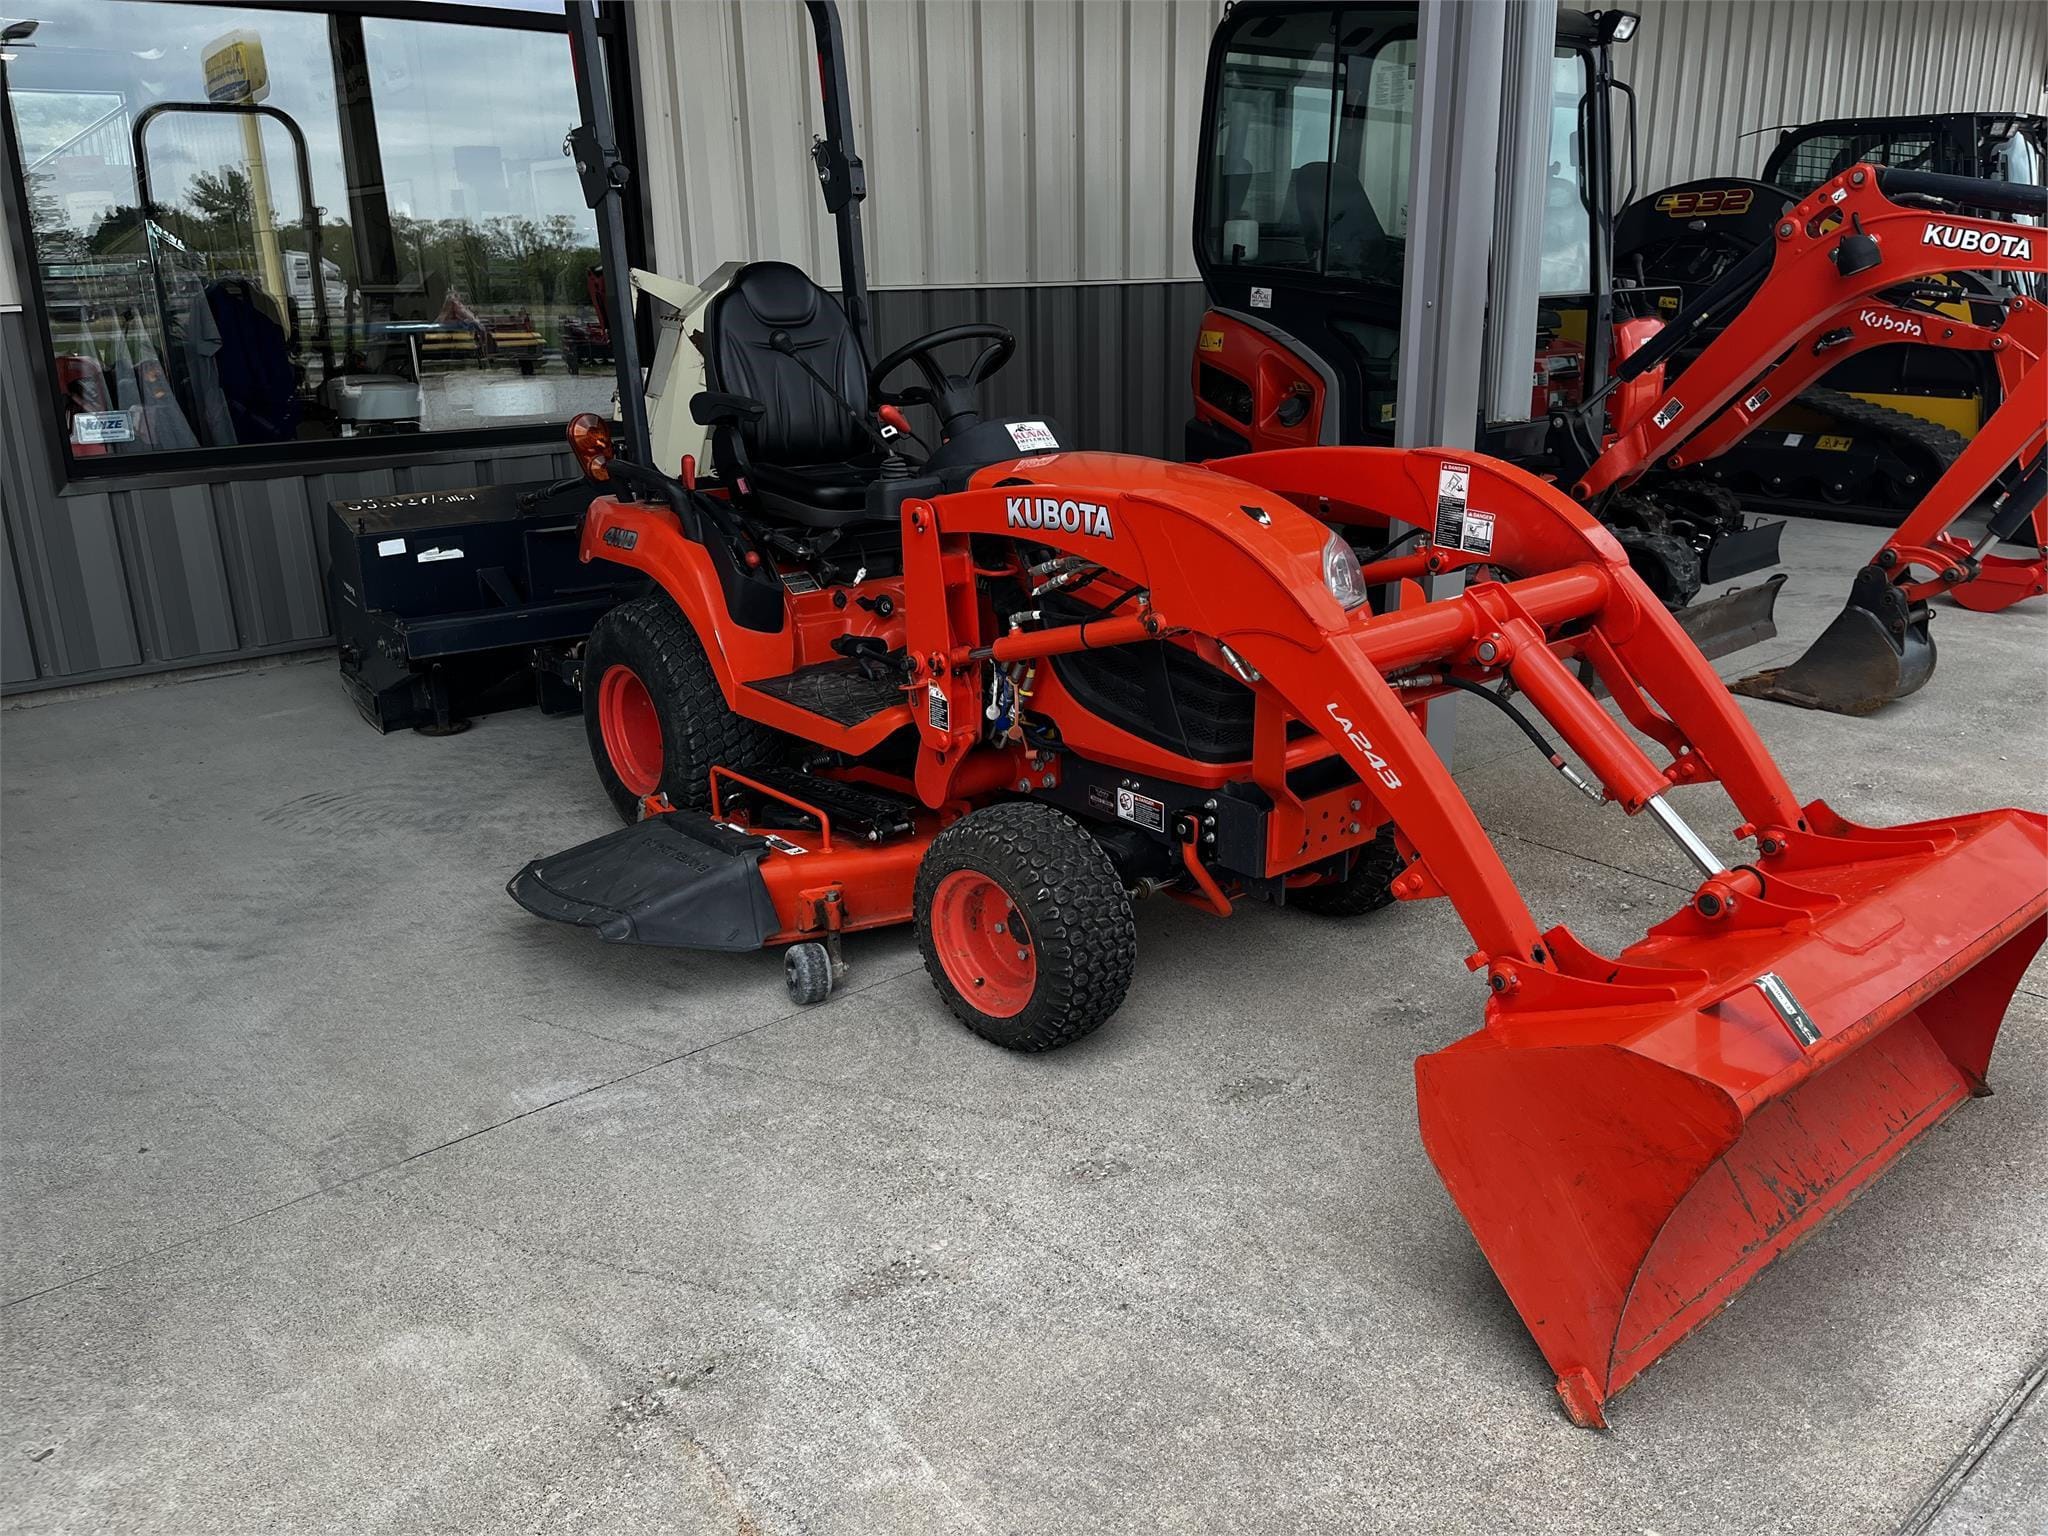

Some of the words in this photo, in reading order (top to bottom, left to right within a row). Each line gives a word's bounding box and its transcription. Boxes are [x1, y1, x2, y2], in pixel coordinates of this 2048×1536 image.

[1922, 223, 2032, 260] KUBOTA
[1860, 309, 1922, 337] Kubota
[85, 419, 124, 430] KINZE
[1447, 465, 1468, 473] DANGER
[1006, 497, 1115, 540] KUBOTA
[1472, 512, 1494, 520] DANGER
[603, 526, 638, 550] 4WD
[1326, 702, 1403, 790] LA243
